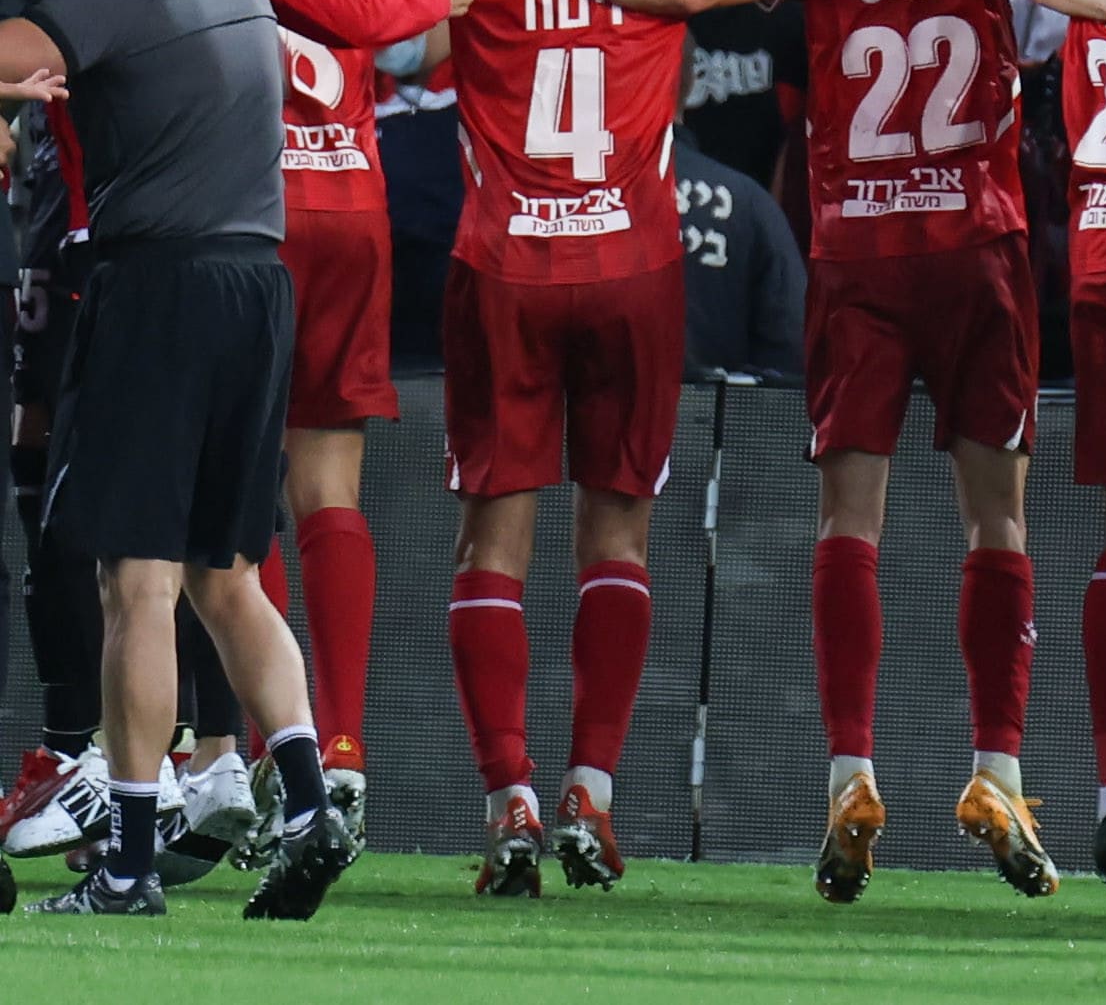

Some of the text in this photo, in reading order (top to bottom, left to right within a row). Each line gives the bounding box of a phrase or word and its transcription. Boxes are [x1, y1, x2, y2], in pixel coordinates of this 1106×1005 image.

[524, 47, 615, 182] 4
[841, 15, 988, 164] 22
[108, 799, 123, 853] KELME
